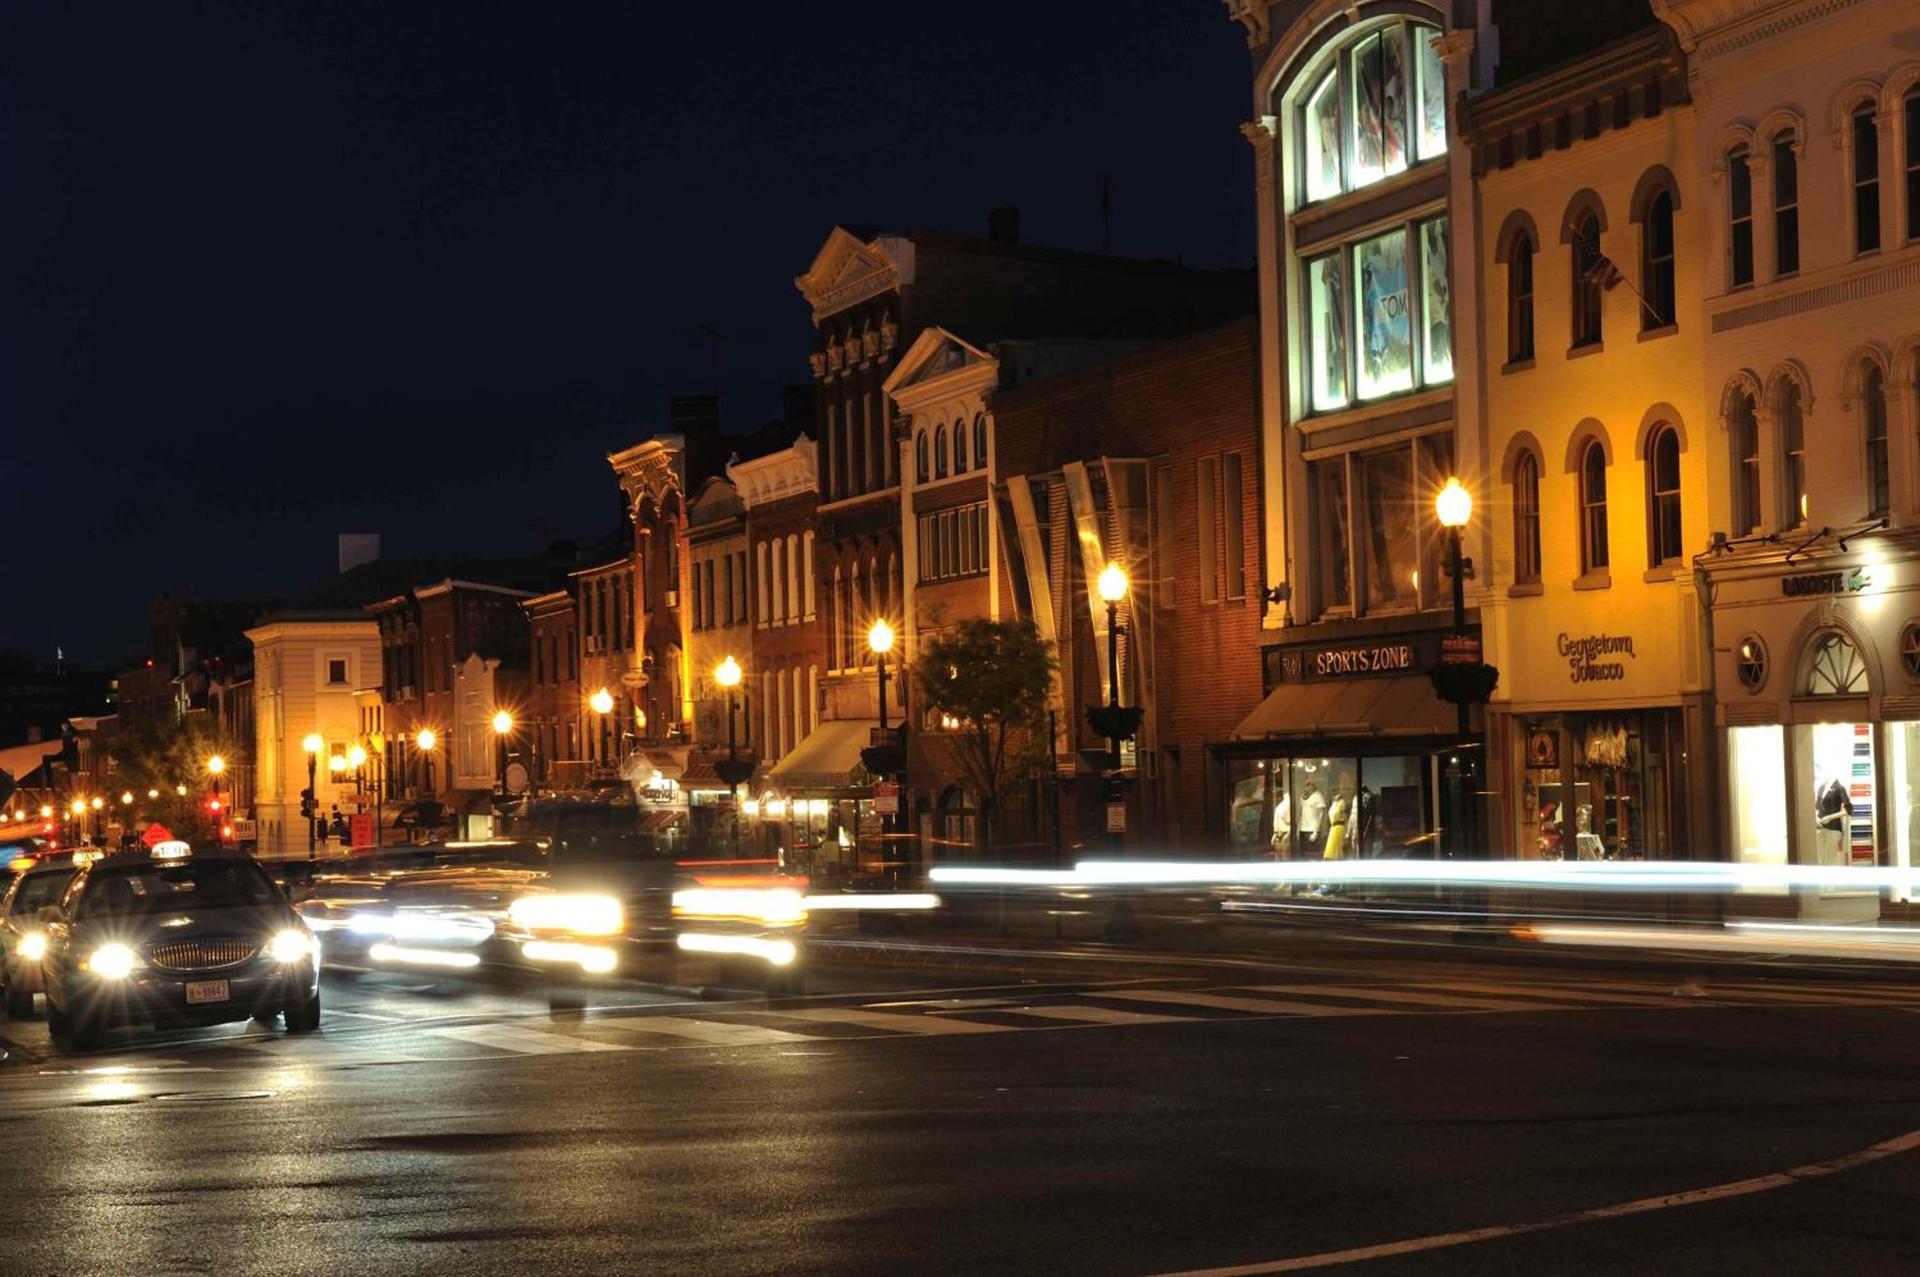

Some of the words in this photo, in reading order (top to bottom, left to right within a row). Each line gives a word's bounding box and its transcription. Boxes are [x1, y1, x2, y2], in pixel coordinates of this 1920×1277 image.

[1557, 632, 1636, 660] Georgetown
[1316, 650, 1369, 675] SPORTS
[1371, 646, 1409, 671] ZONE
[1569, 657, 1624, 684] Tobacco
